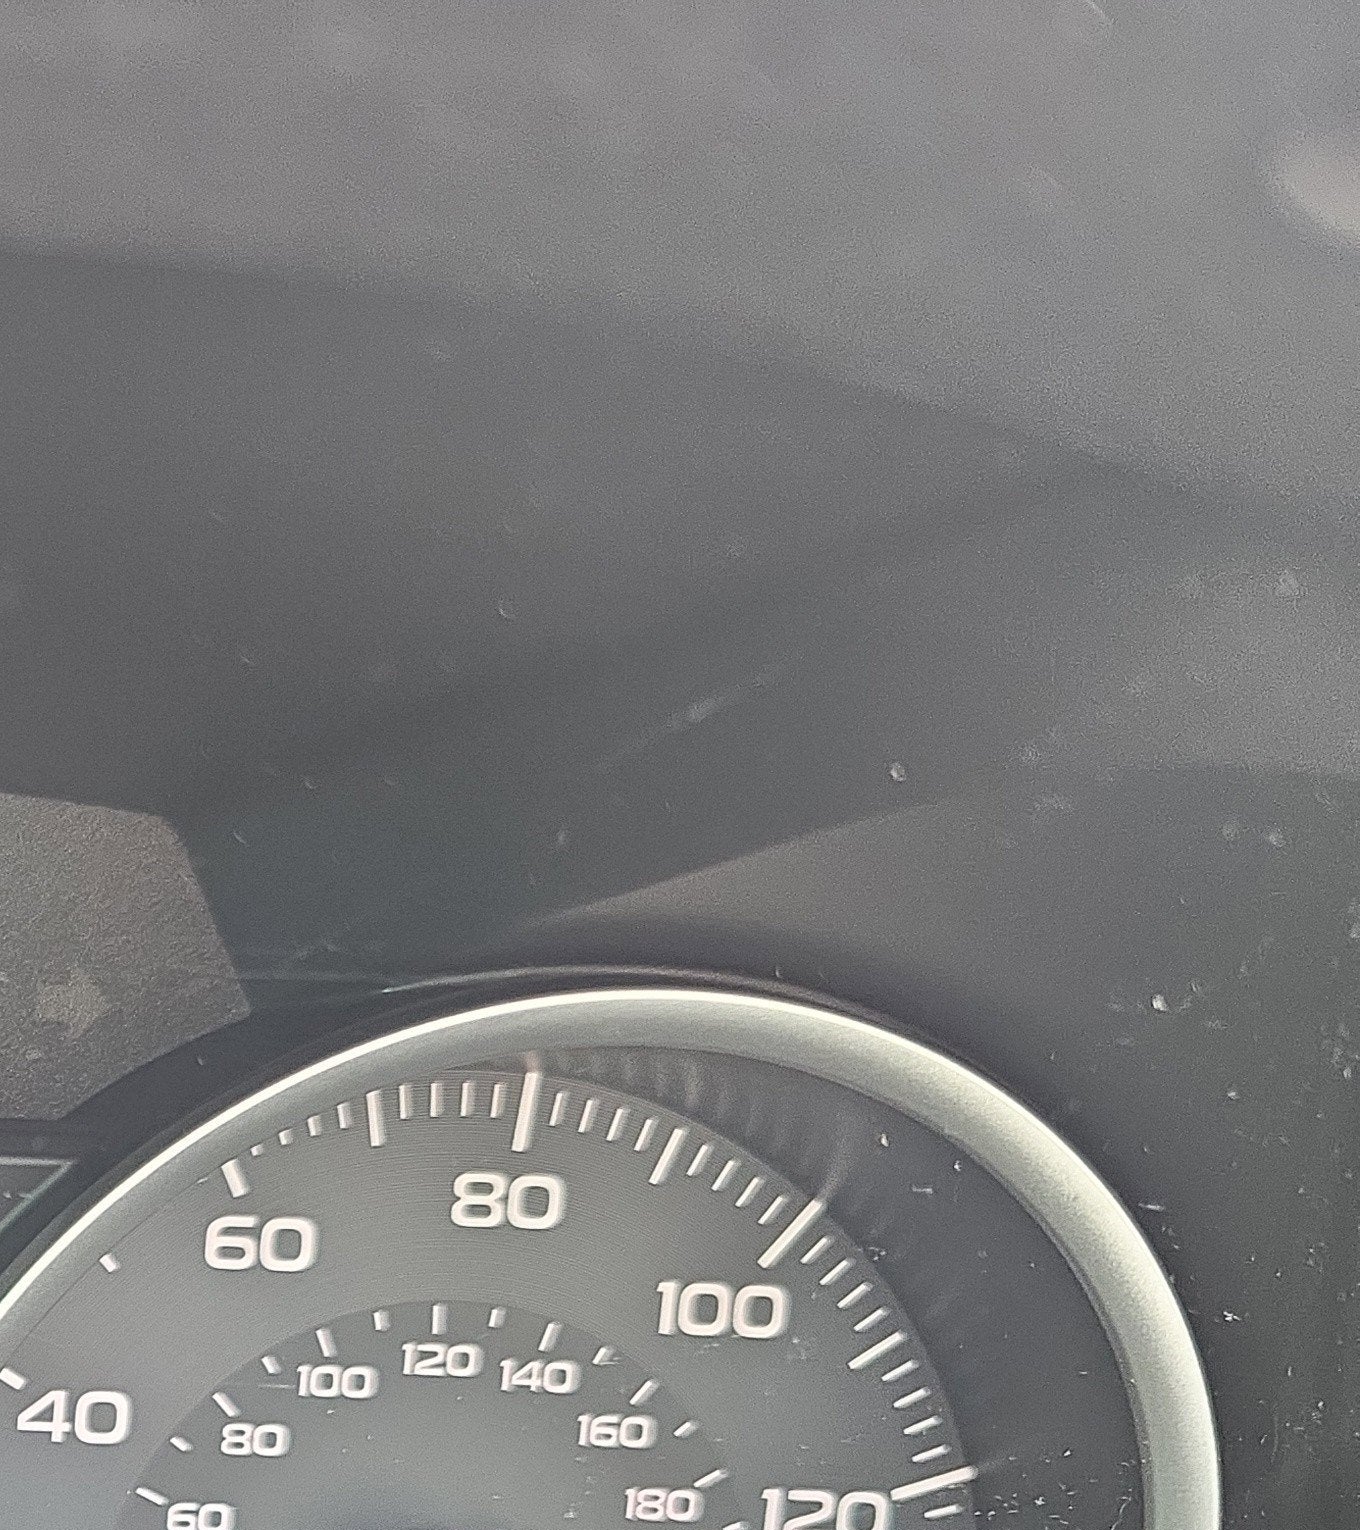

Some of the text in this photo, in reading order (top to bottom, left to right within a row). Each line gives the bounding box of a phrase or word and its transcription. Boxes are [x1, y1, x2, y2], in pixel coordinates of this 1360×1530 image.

[450, 1173, 567, 1230] 80
[203, 1215, 318, 1273] 60
[656, 1280, 790, 1339] 100
[402, 1342, 482, 1378] 120
[499, 1358, 581, 1395] 140
[296, 1364, 379, 1400] 100
[16, 1389, 133, 1446] 40
[577, 1413, 658, 1449] 160
[220, 1422, 291, 1457] 80
[624, 1487, 705, 1523] 180
